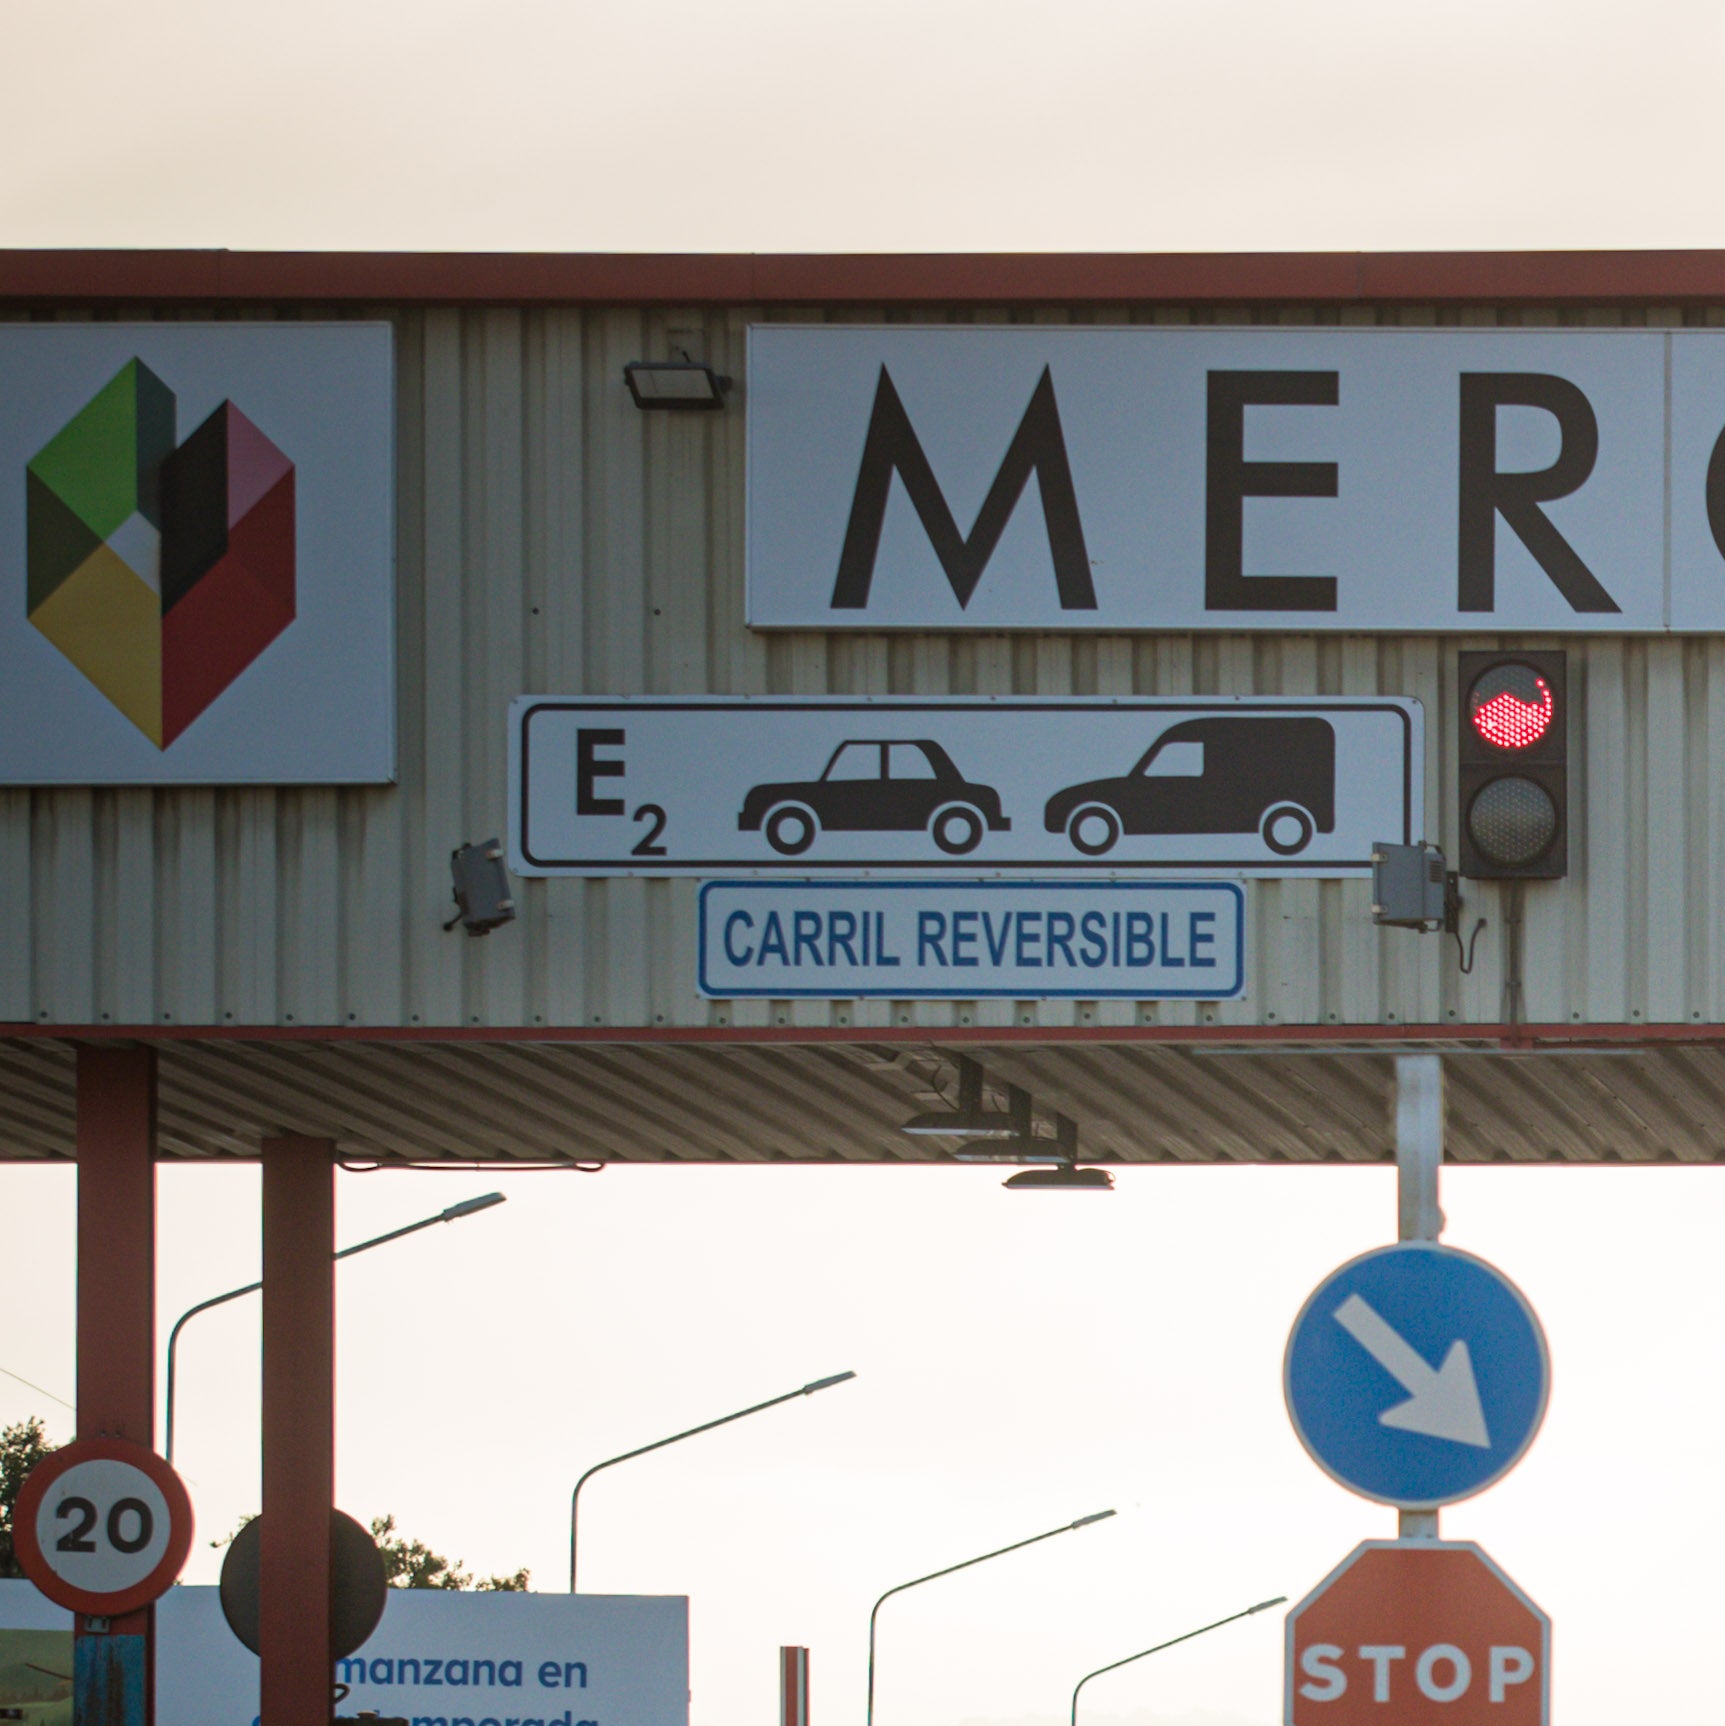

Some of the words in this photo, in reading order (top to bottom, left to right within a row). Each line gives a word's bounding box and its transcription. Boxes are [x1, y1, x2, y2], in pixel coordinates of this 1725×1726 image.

[722, 909, 901, 969] CARRIL
[917, 909, 1217, 970] REVERSIBLE
[55, 1496, 154, 1554] 20
[335, 1656, 524, 1687] manzana
[537, 1660, 589, 1689] en
[1299, 1643, 1536, 1703] STOP
